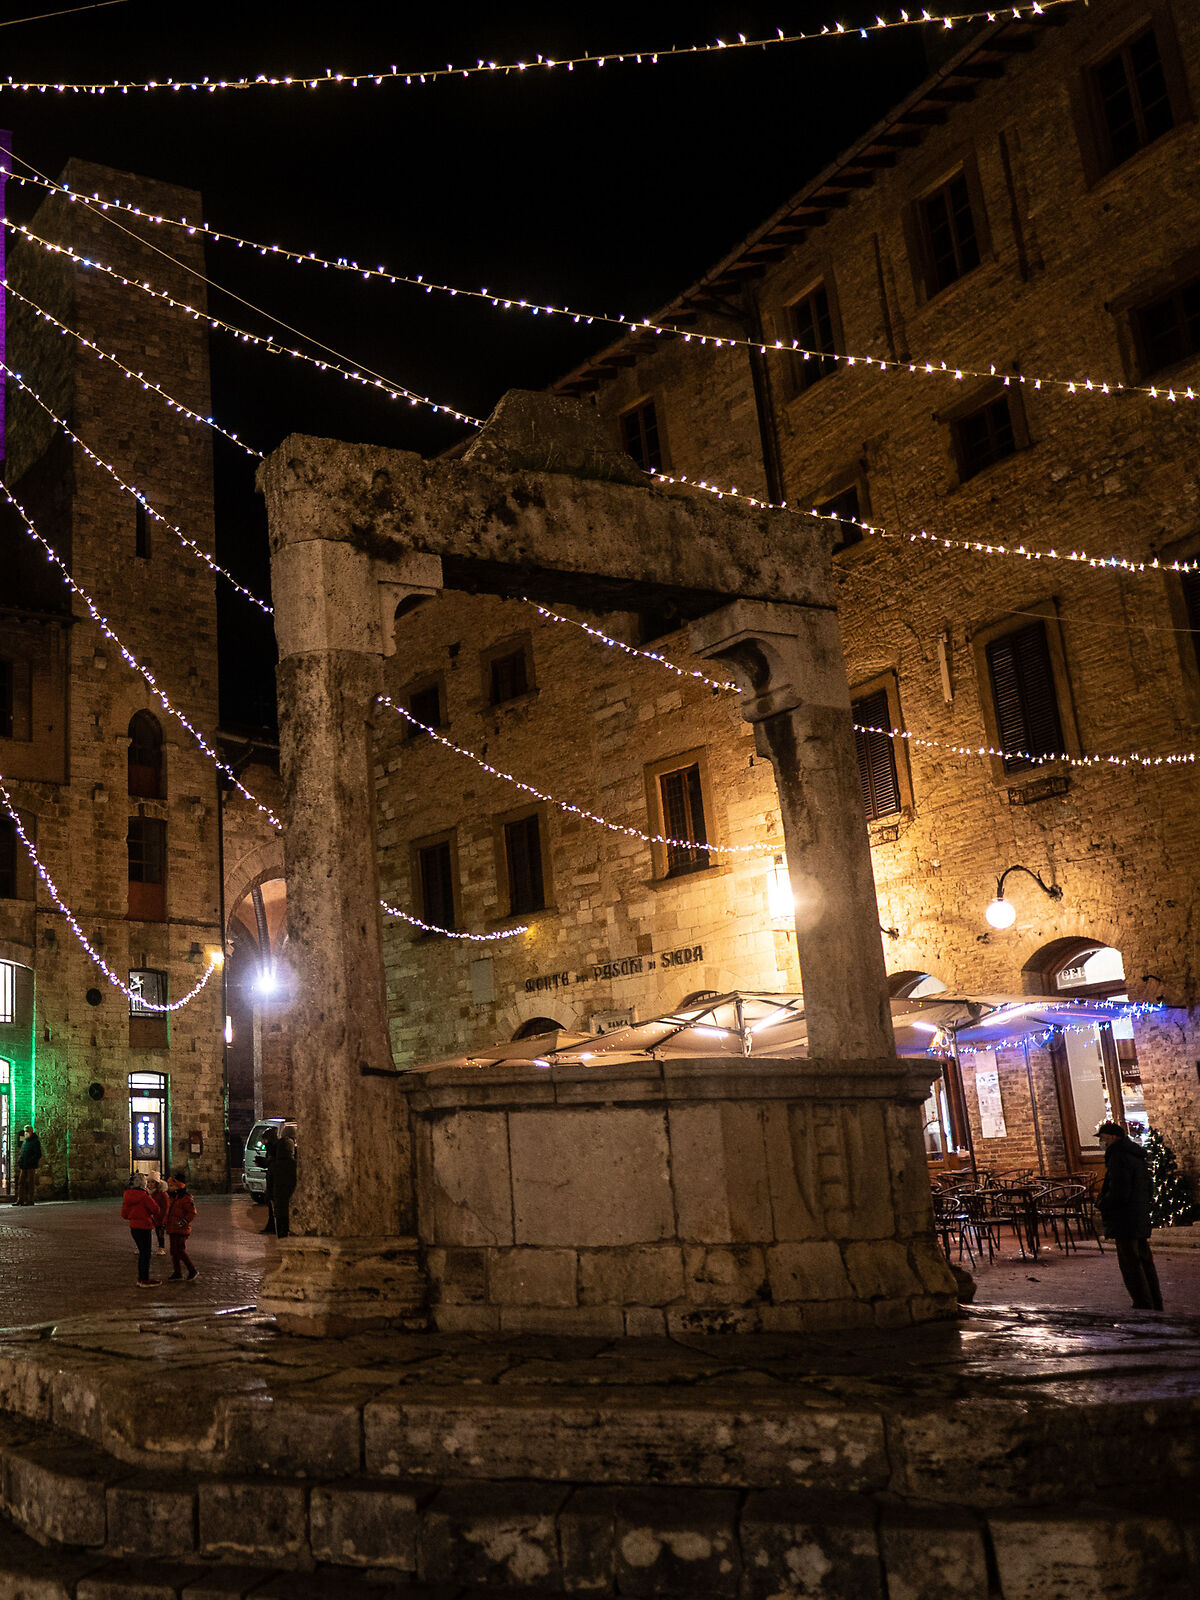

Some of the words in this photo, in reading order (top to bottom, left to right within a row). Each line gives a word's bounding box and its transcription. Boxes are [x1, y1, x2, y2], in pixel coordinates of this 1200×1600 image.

[525, 971, 569, 992] MONTE
[593, 958, 643, 980] PASCHI
[661, 945, 704, 968] SIENA
[1062, 967, 1085, 980] GEL
